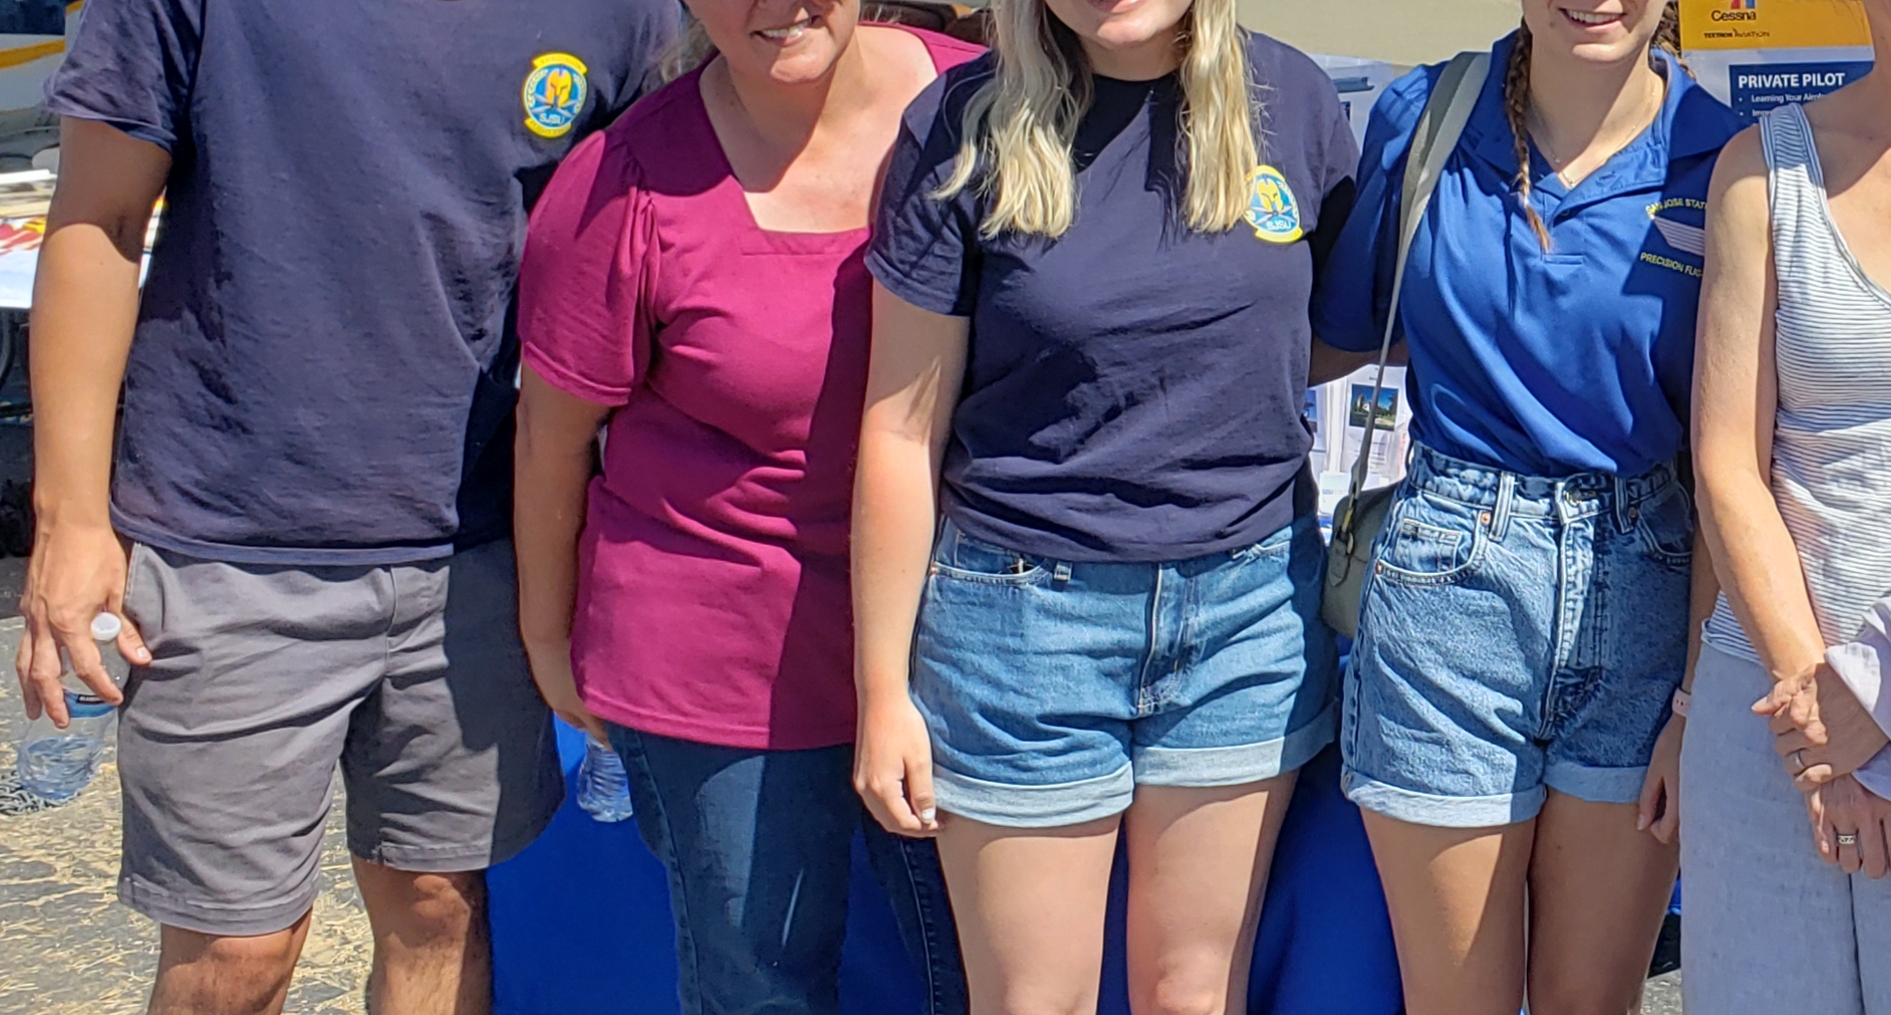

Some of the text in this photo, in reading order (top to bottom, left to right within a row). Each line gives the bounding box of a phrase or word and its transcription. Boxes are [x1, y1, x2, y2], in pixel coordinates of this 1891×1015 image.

[1711, 9, 1757, 22] Cessna
[1738, 72, 1846, 88] PRIVATE PILOT
[1751, 94, 1784, 104] Learning
[1685, 265, 1704, 277] FLIG
